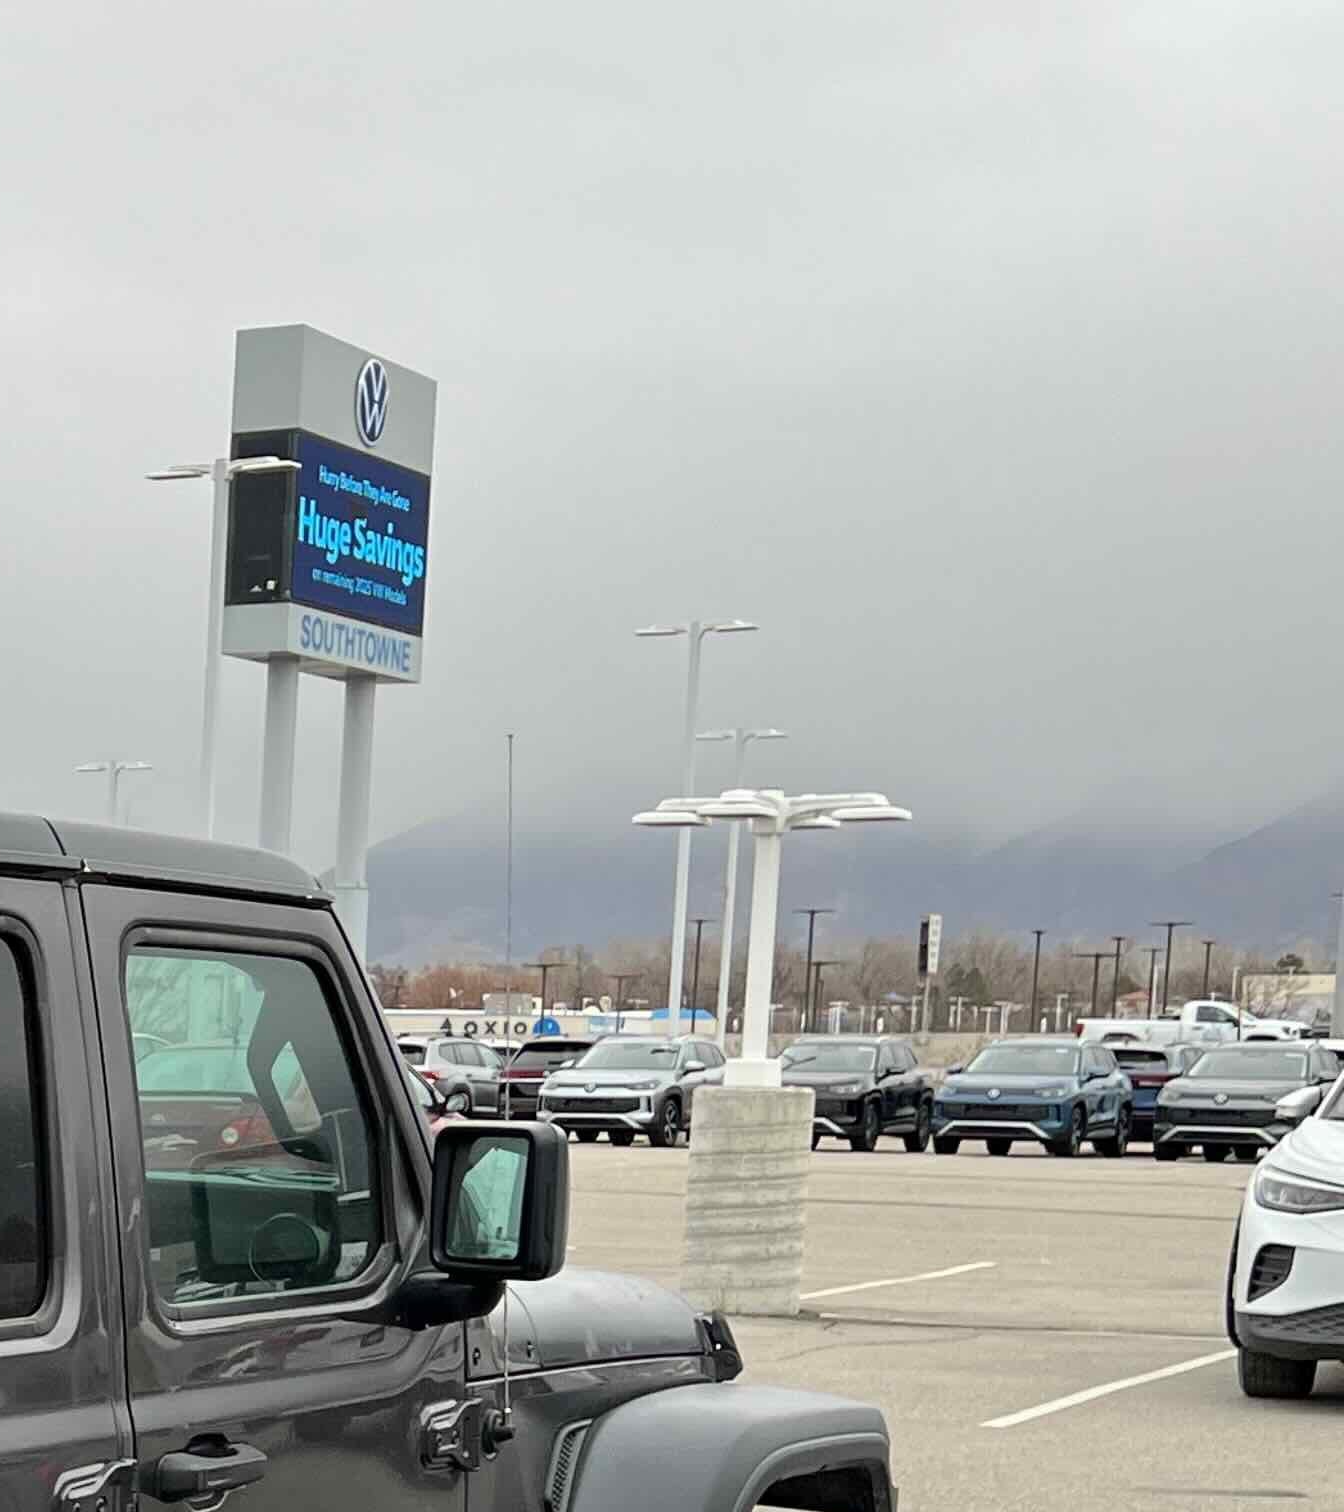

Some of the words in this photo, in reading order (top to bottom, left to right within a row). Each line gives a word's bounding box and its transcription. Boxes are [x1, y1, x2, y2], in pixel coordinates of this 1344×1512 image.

[298, 496, 351, 564] Huge
[353, 518, 424, 586] Savings
[301, 613, 411, 672] SOUTHTOWNE
